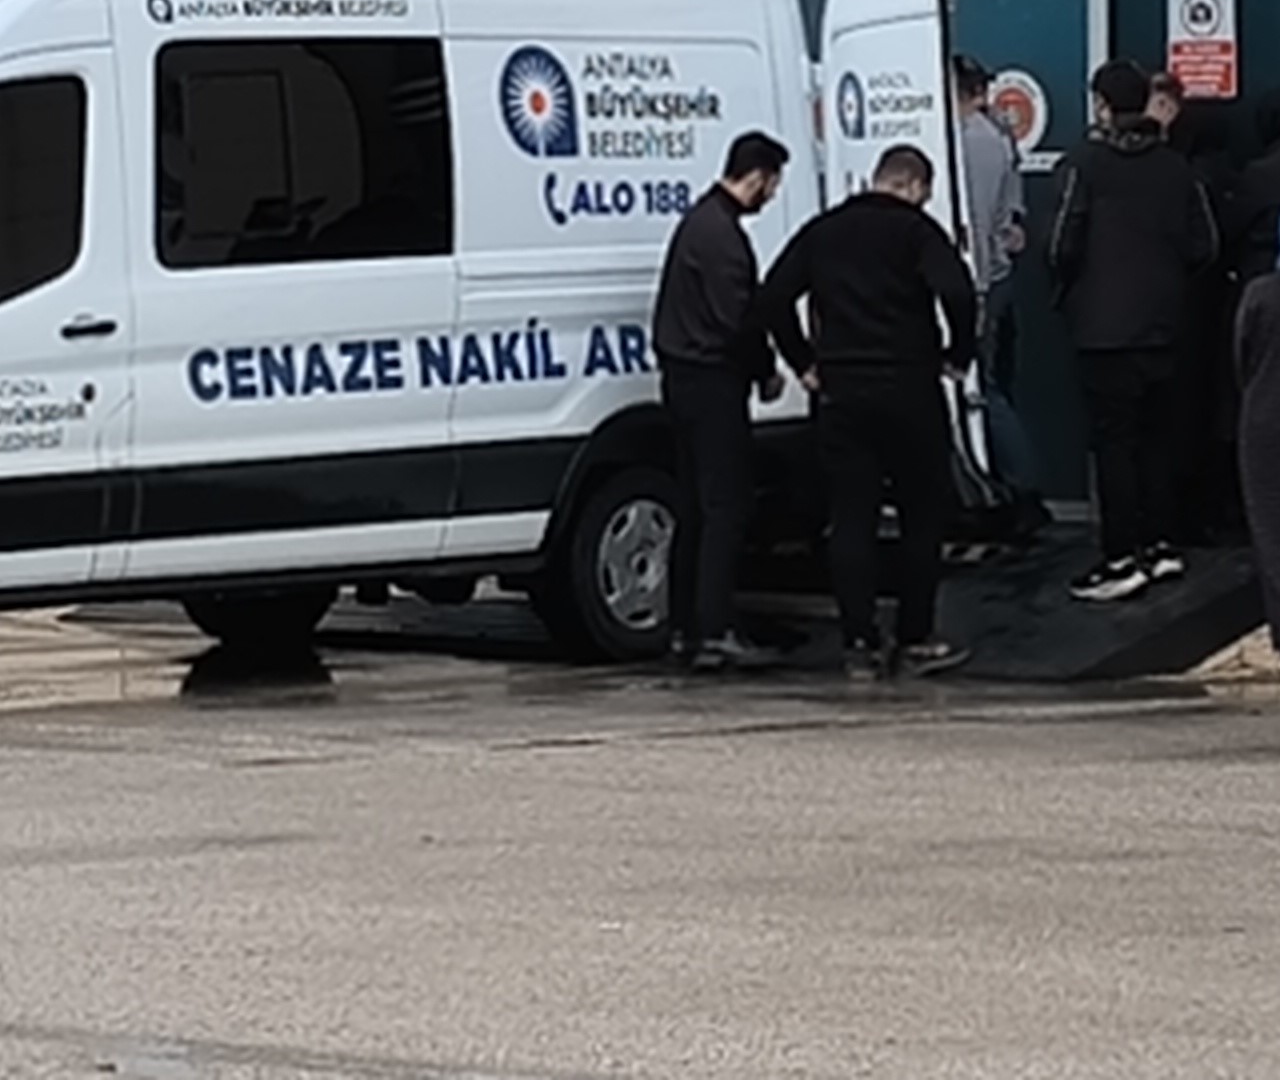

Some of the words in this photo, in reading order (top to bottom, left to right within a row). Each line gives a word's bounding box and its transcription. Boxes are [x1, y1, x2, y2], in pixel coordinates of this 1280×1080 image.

[581, 52, 674, 80] ANTALYA
[585, 83, 721, 124] BÜYÜKŞEHİR
[587, 124, 695, 159] BELEDİYESİ
[570, 180, 636, 216] ALO
[641, 180, 690, 216] 188
[188, 338, 405, 402] CENAZE
[416, 316, 567, 389] NAKİL
